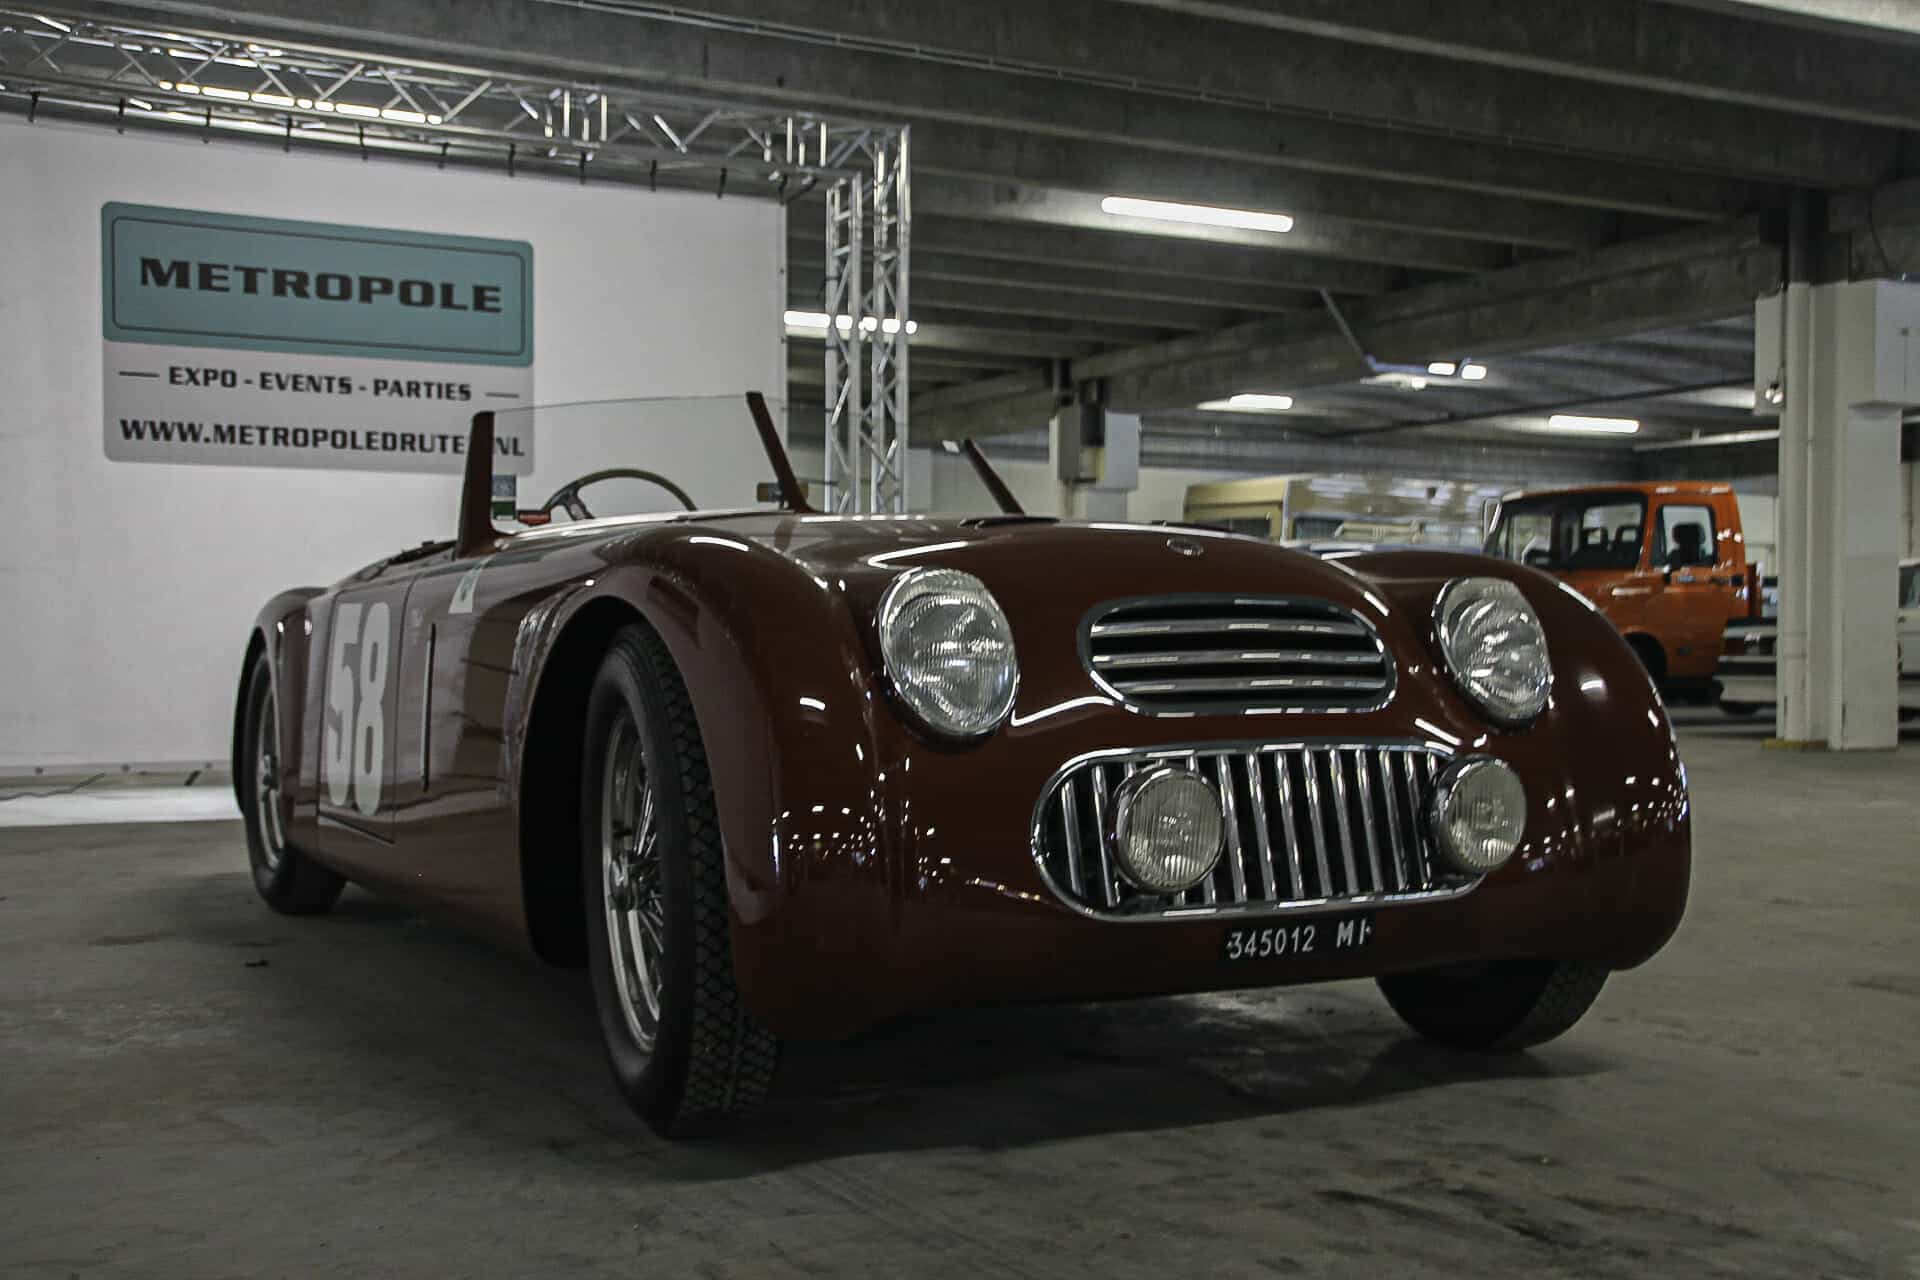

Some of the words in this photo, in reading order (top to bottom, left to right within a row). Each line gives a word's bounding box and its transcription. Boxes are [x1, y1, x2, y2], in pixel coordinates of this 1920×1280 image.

[139, 257, 503, 313] METROPOLE
[168, 366, 238, 388] EXPO
[259, 372, 353, 395] EVENTS
[373, 378, 472, 401] PARTIES
[120, 418, 525, 457] WWW.METROPOLEDRUTENL
[325, 602, 390, 817] 58
[1229, 925, 1316, 960] 345012
